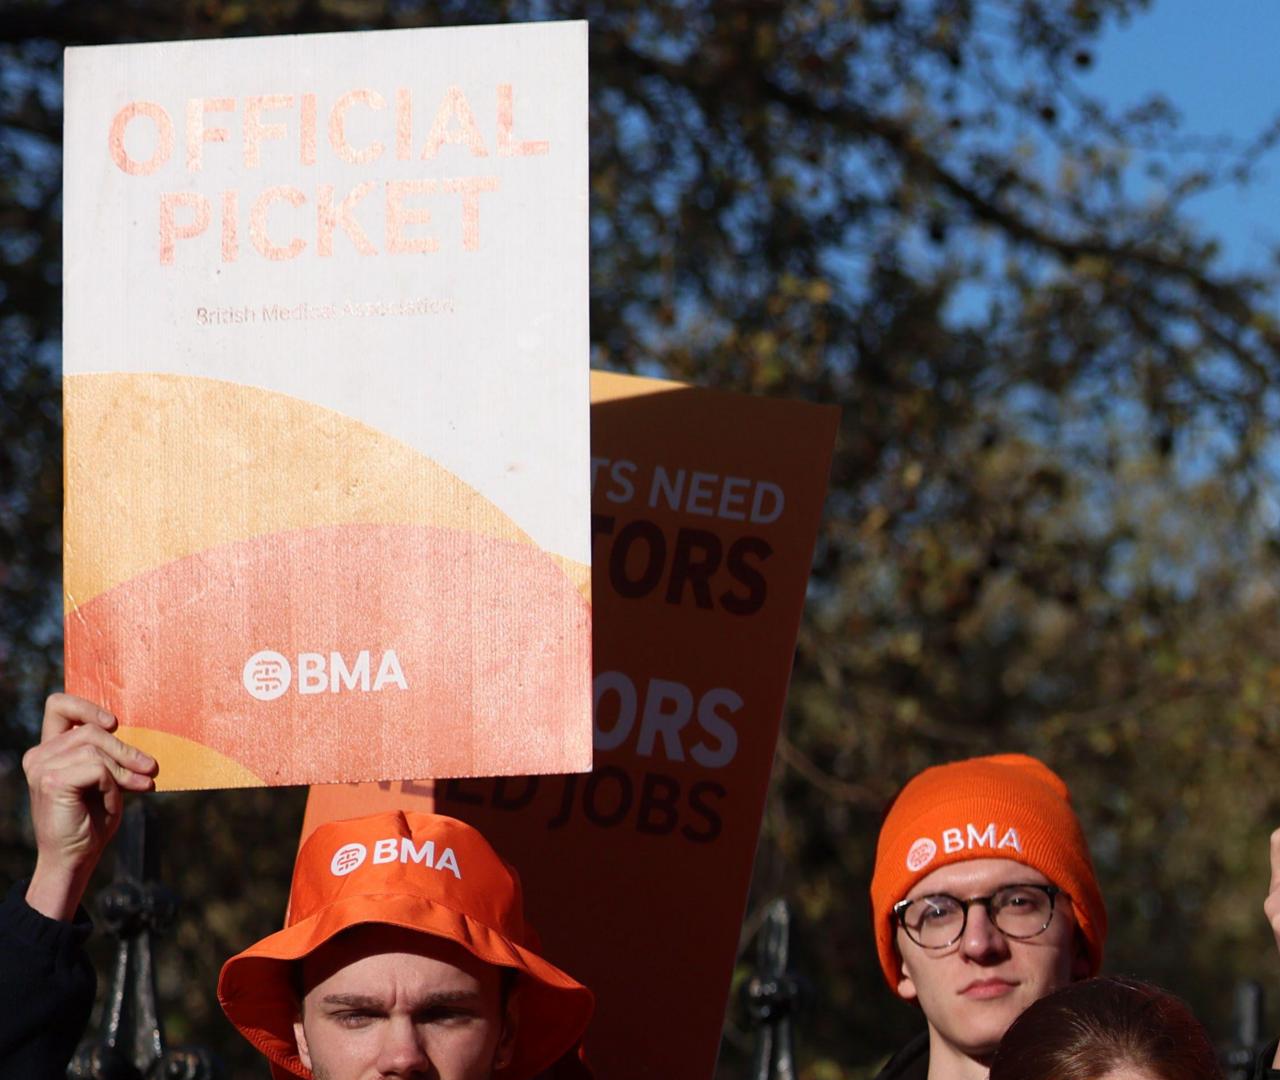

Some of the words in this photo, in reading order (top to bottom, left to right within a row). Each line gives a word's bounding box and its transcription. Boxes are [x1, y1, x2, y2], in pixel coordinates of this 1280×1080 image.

[107, 83, 550, 176] OFFICIAL
[158, 175, 501, 266] PICKET
[196, 306, 256, 326] British
[648, 466, 785, 524] NEED
[298, 650, 408, 695] BMA
[373, 837, 462, 879] BMA
[942, 823, 1022, 855] BMA
